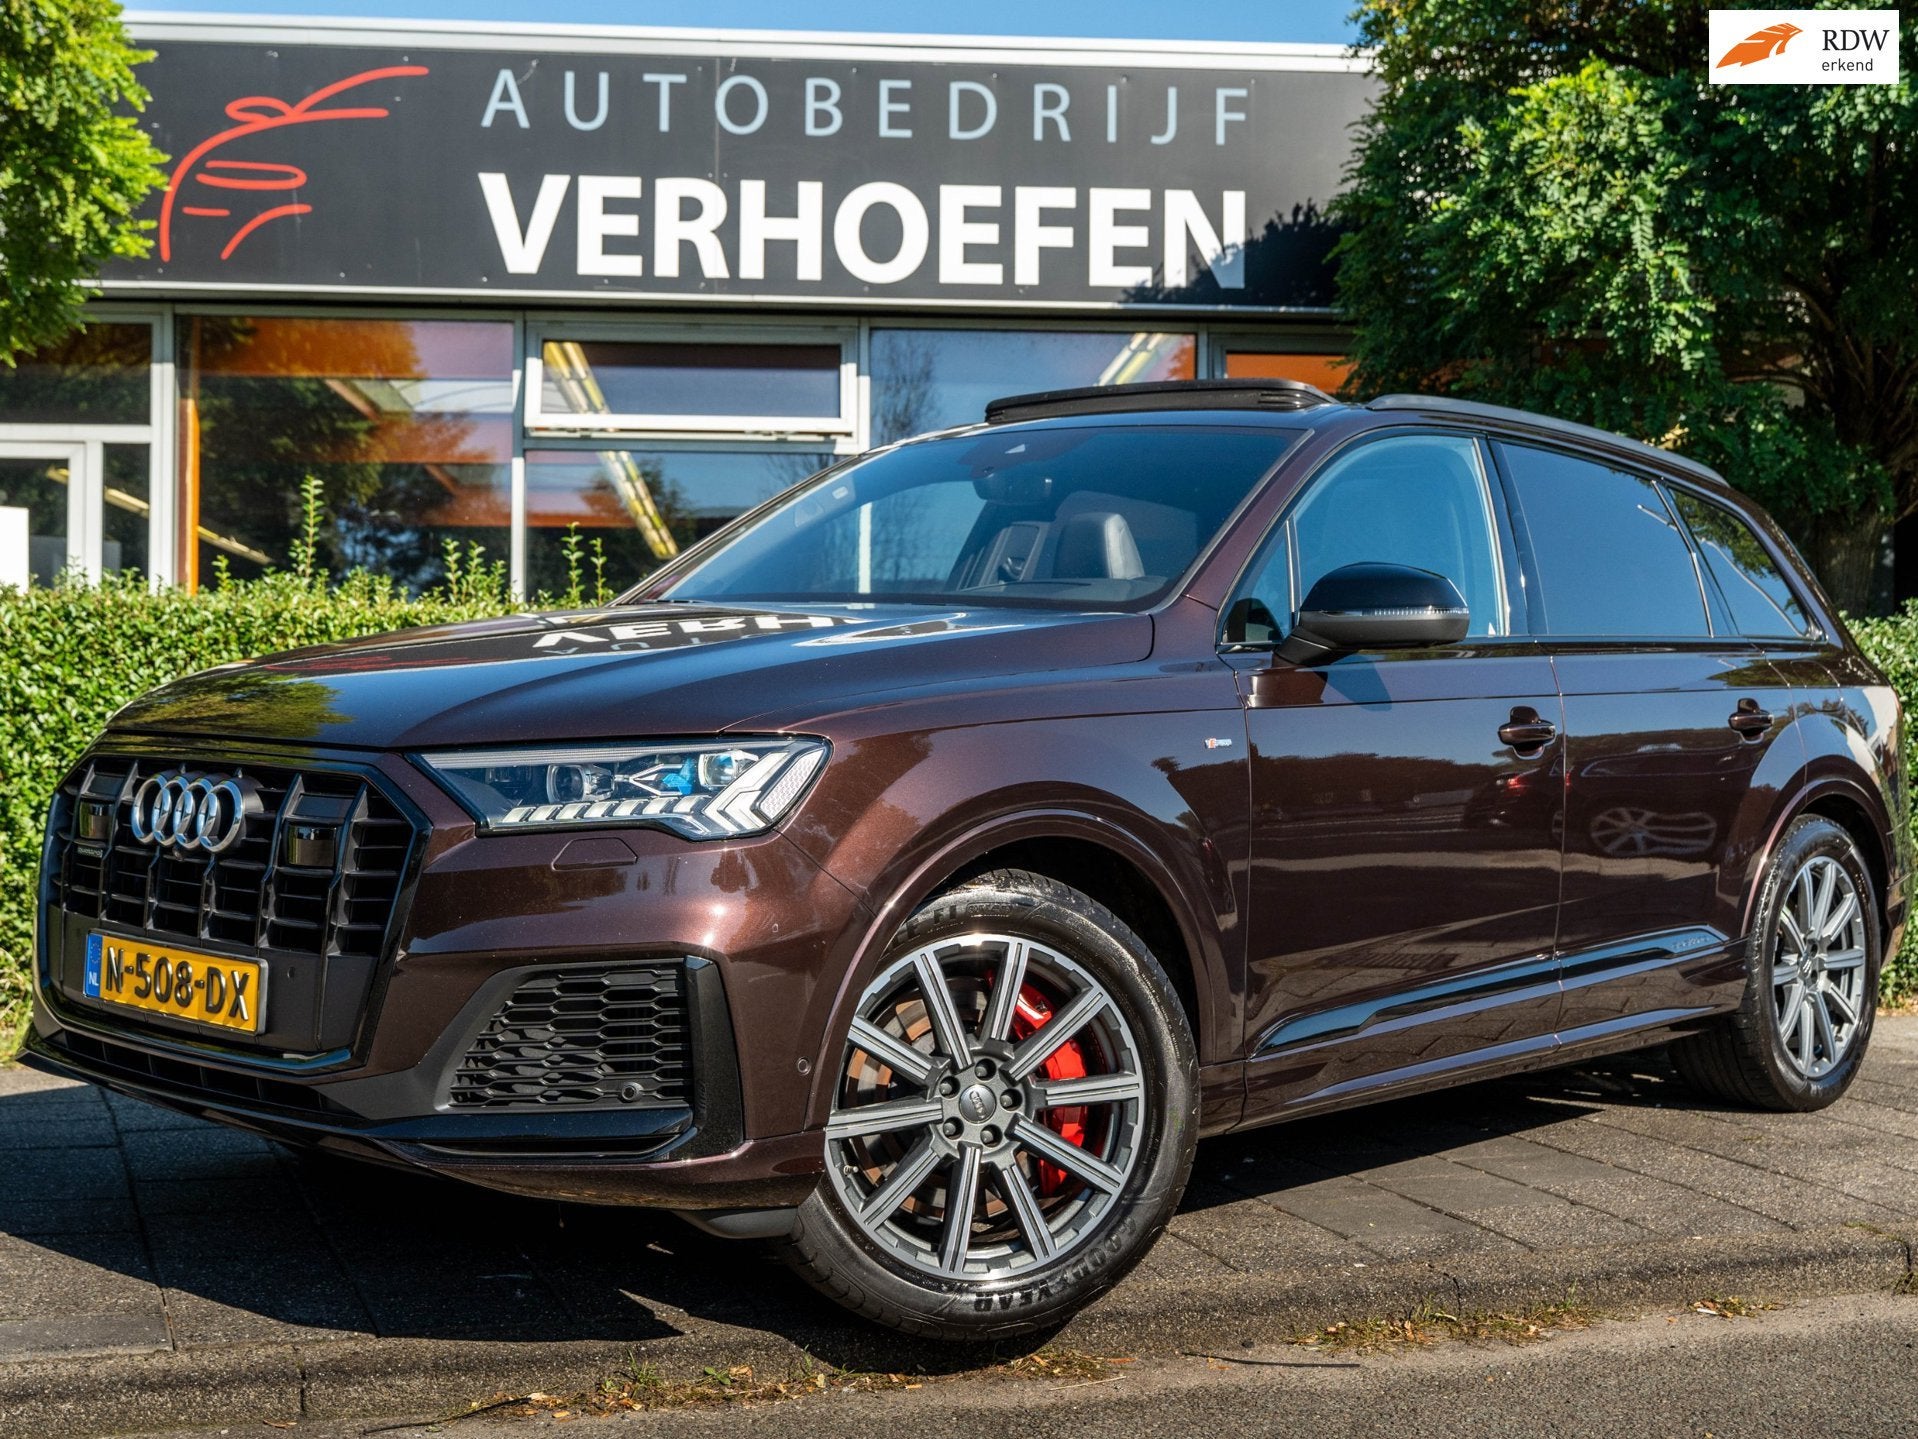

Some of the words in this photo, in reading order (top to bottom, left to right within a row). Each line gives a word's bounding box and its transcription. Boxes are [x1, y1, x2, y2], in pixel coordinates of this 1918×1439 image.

[480, 68, 1249, 146] AUTOBEDRIJF
[478, 171, 1246, 290] VERHOEFEN
[88, 972, 99, 986] NL
[105, 946, 251, 1021] N-508-DX
